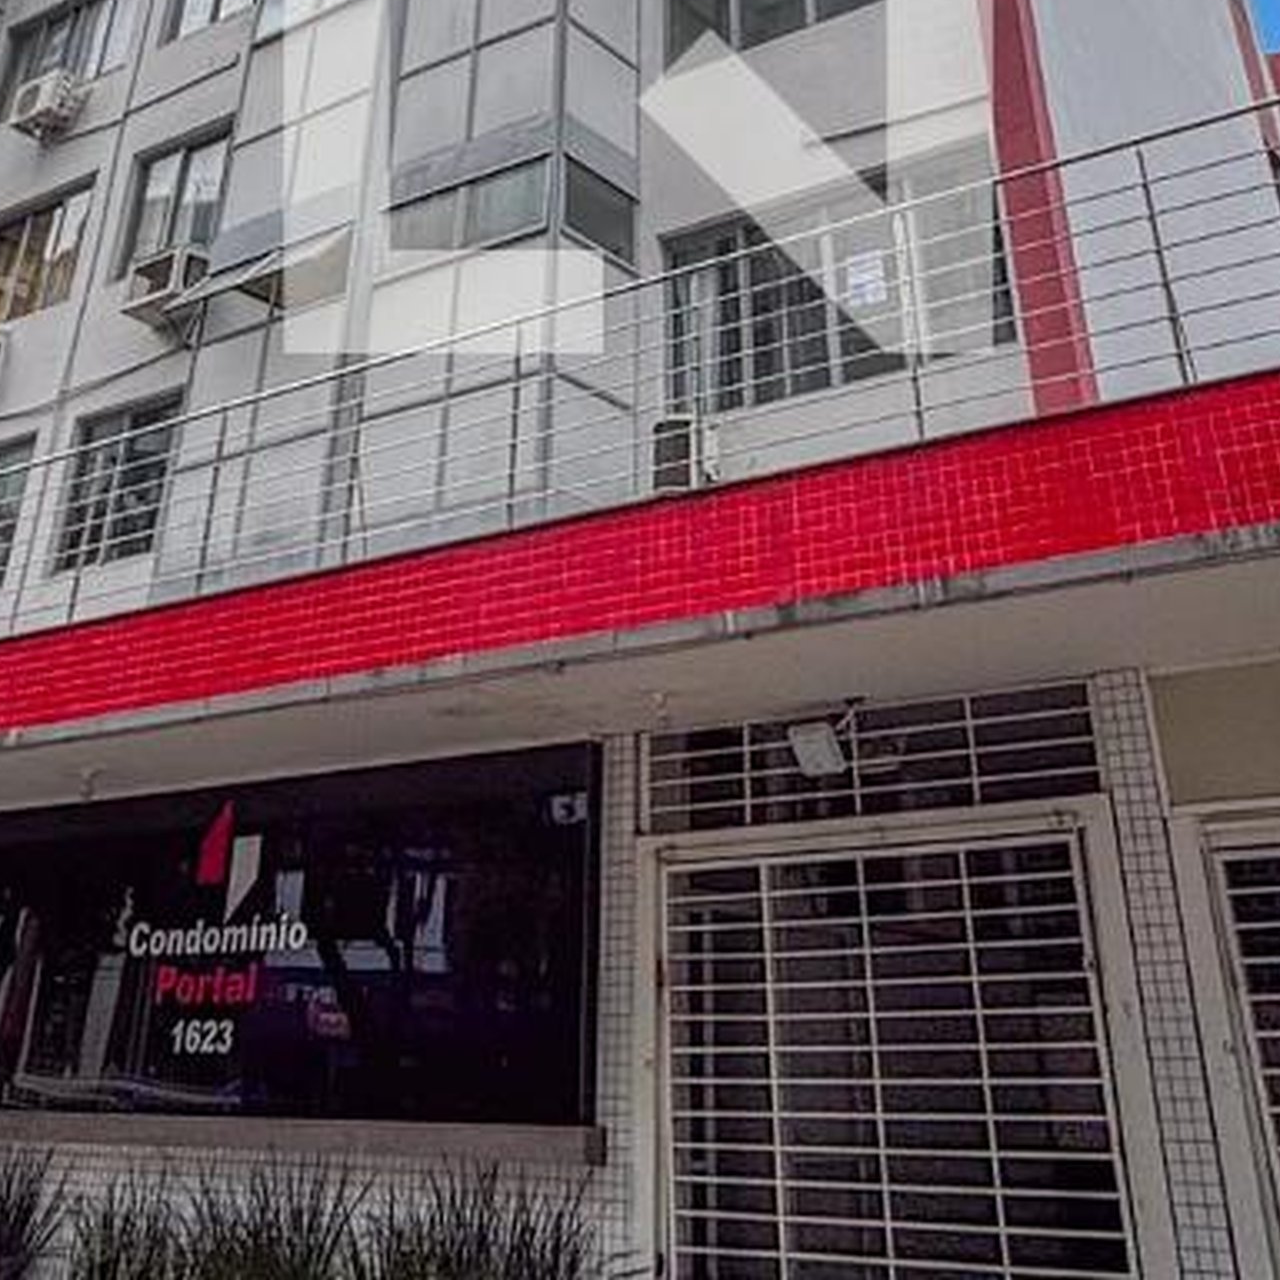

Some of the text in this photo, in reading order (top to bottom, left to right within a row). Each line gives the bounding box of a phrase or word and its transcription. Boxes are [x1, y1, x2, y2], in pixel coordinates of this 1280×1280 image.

[129, 913, 308, 957] Condomínio
[155, 962, 259, 1005] Portal
[170, 1019, 234, 1054] 1623
